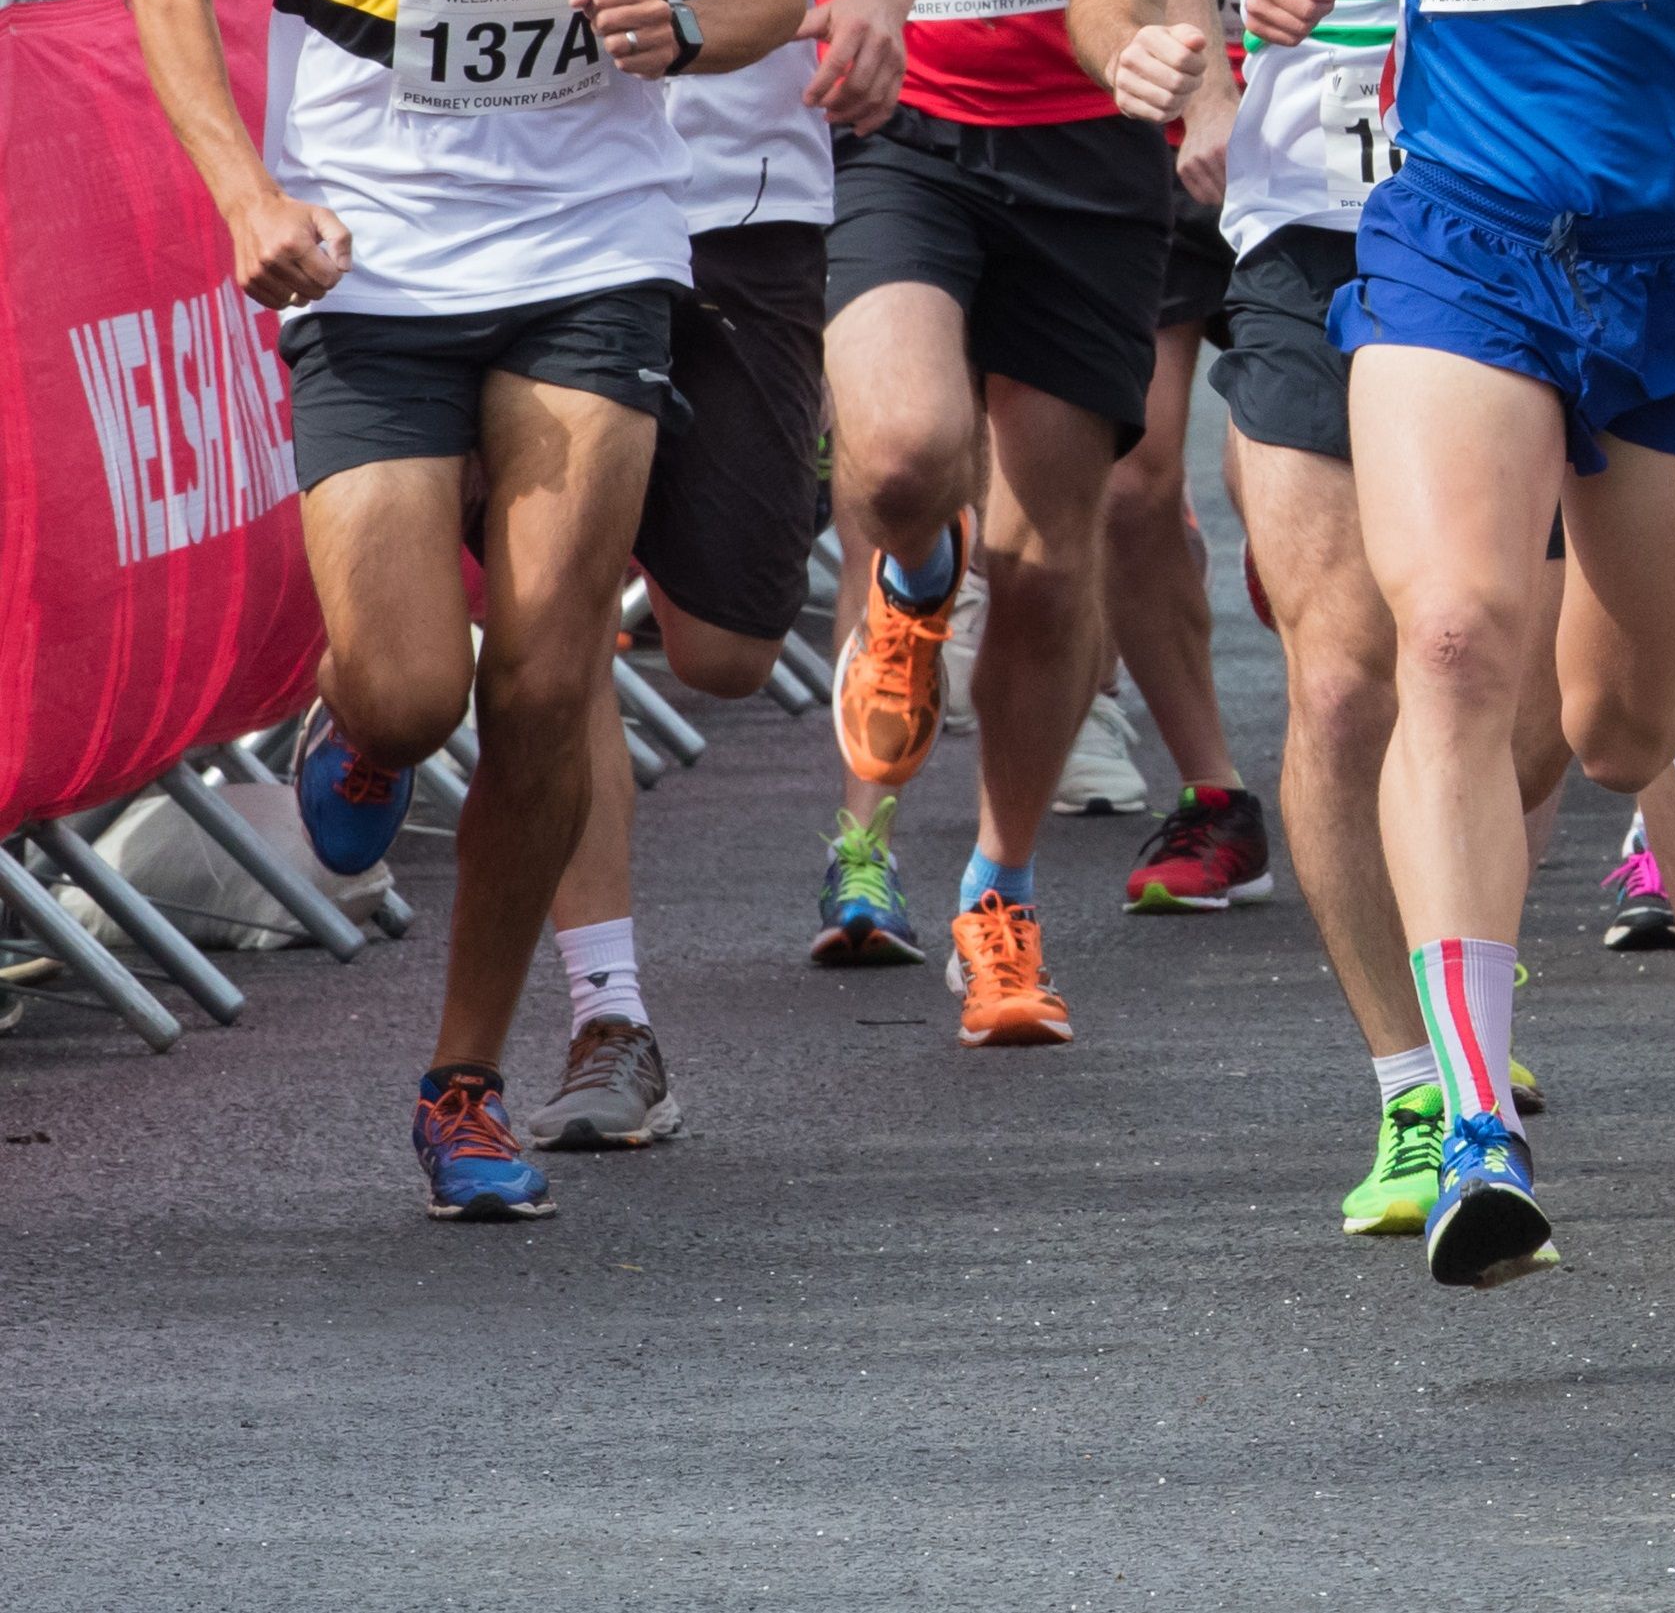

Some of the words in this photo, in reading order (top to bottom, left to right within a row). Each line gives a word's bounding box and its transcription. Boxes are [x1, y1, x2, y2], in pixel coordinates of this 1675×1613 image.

[420, 11, 599, 83] 137A
[403, 92, 472, 109] PEMBREY
[475, 93, 539, 108] COUNTRY
[542, 86, 575, 102] PARK
